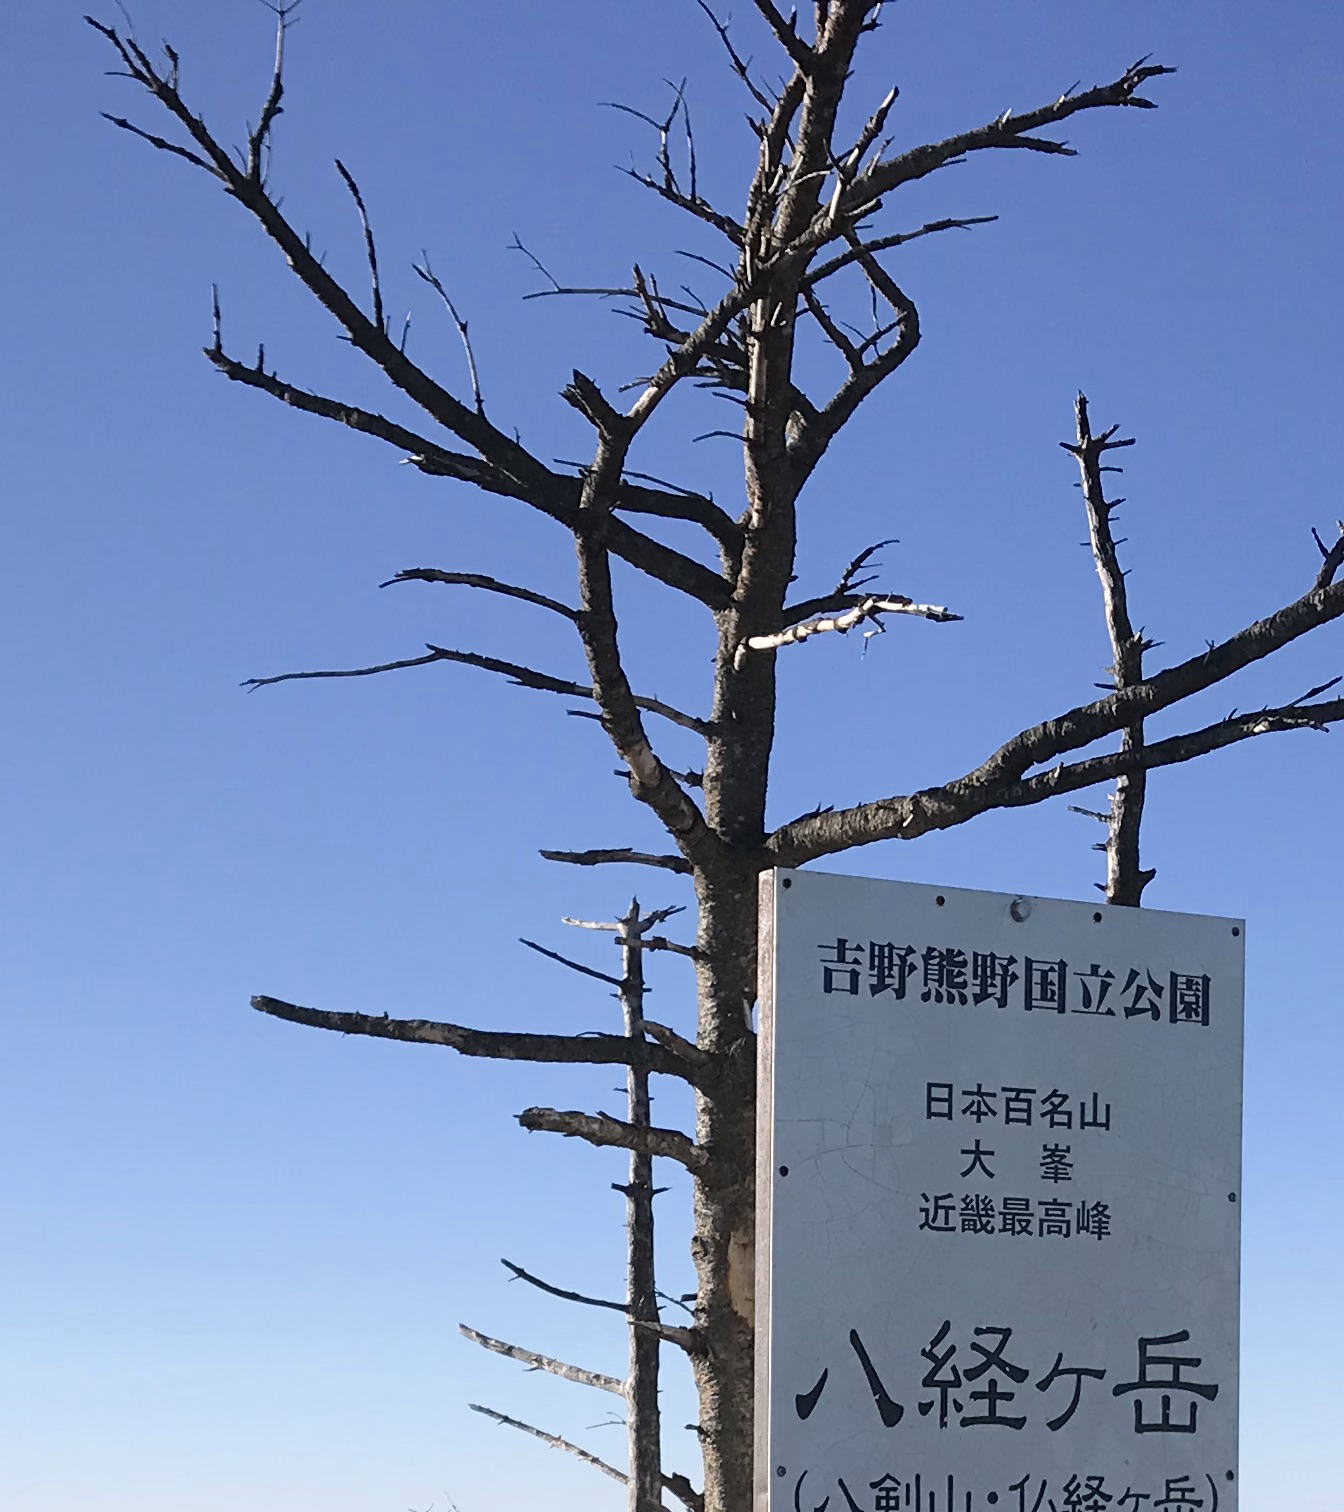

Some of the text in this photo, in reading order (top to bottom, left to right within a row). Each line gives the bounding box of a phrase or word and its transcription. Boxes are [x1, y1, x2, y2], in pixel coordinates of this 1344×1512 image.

[817, 937, 1212, 1027] 吉野熊野国立公園
[925, 1082, 1111, 1131] 日本百名山
[918, 1192, 1112, 1241] 近畿最高峰
